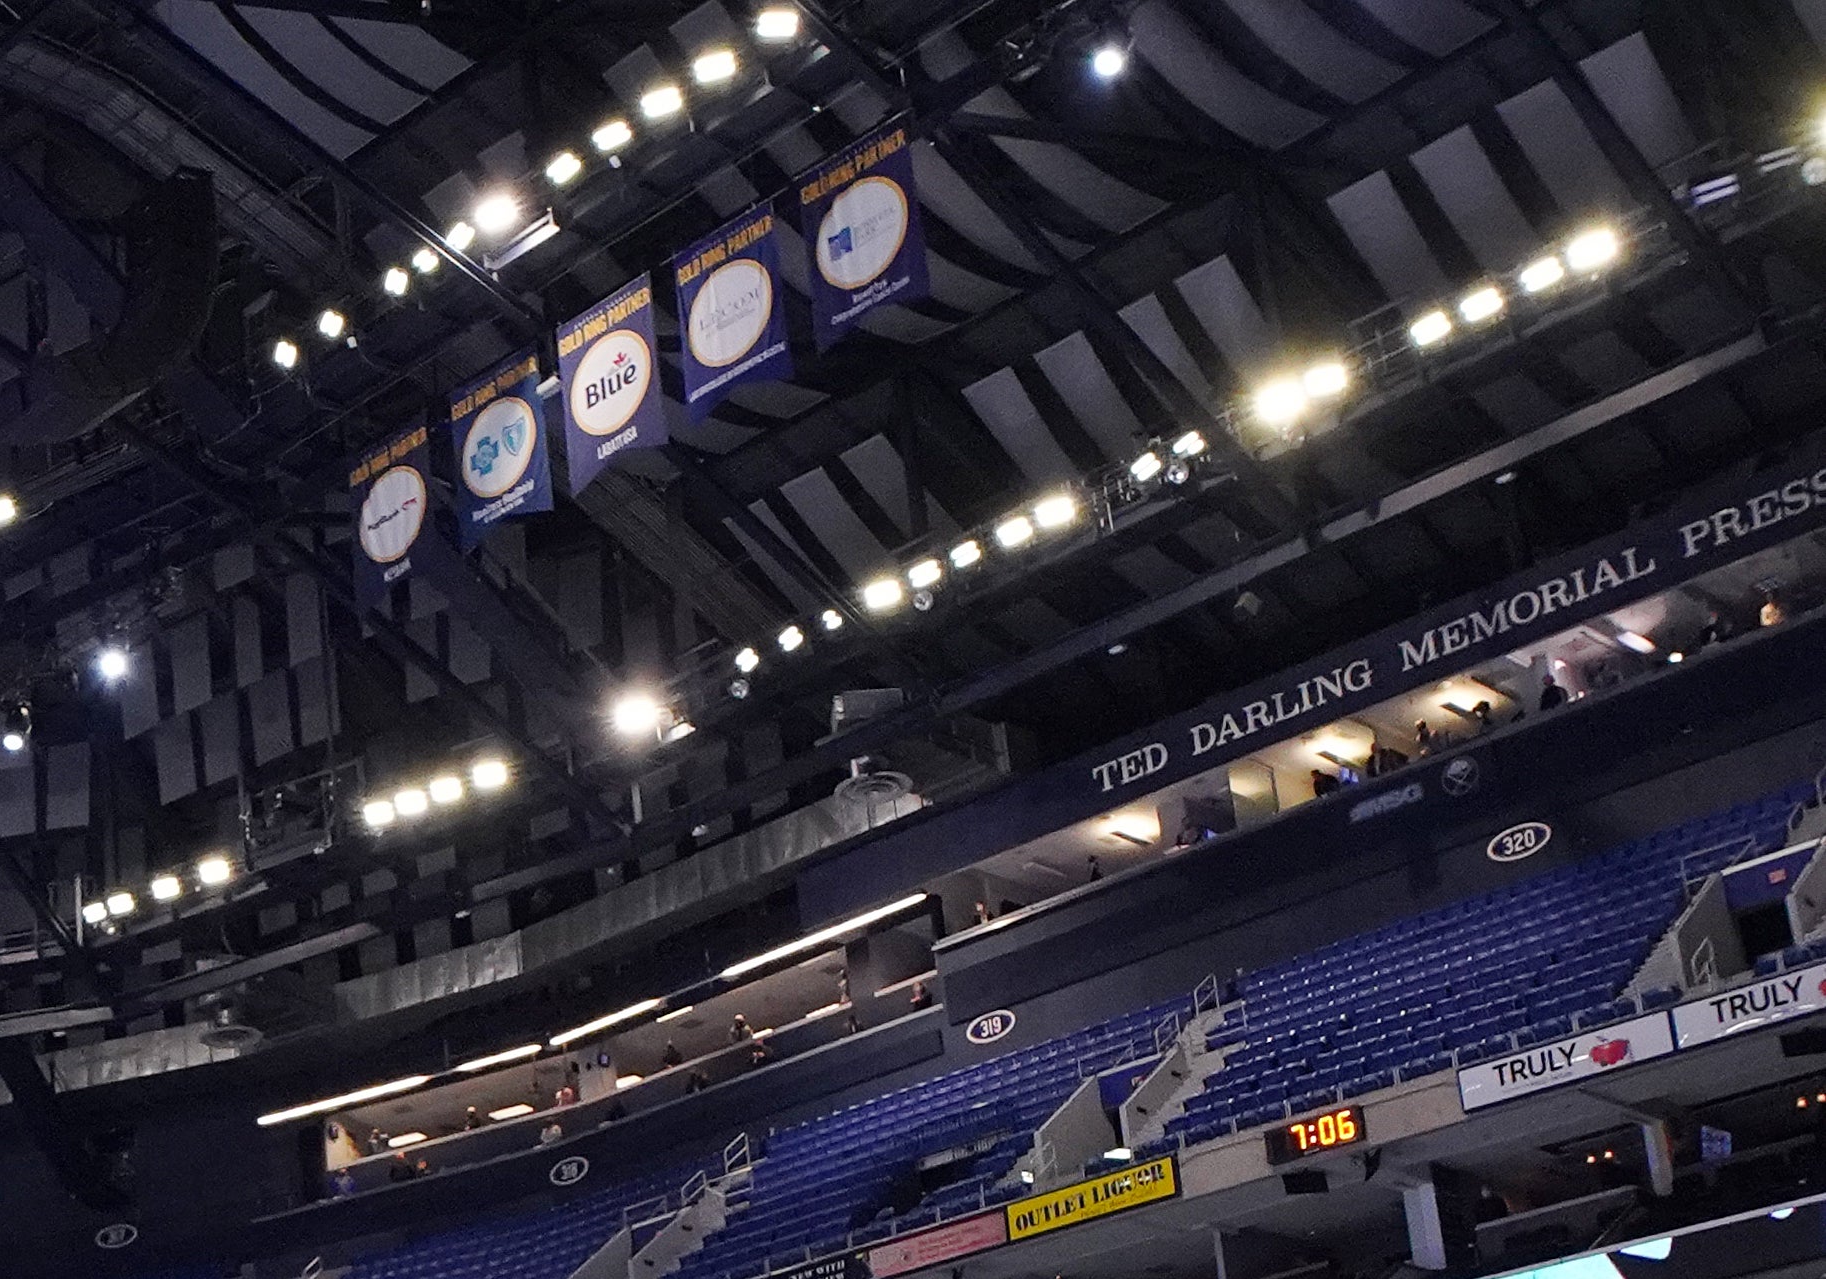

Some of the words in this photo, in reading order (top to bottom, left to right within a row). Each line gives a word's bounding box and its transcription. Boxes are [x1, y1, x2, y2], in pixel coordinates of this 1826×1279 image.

[585, 364, 637, 409] Blue
[1093, 743, 1169, 794] TED
[1190, 659, 1374, 757] DARLING
[1398, 547, 1657, 674] MEMORIAL
[1502, 828, 1536, 855] 320
[1710, 976, 1804, 1025] TRULY
[979, 1015, 1003, 1038] 319
[1492, 1042, 1578, 1087] TRULY
[1290, 1108, 1356, 1152] 7:06
[1015, 1192, 1086, 1232] OUTLET
[1092, 1163, 1165, 1205] LIQUOR
